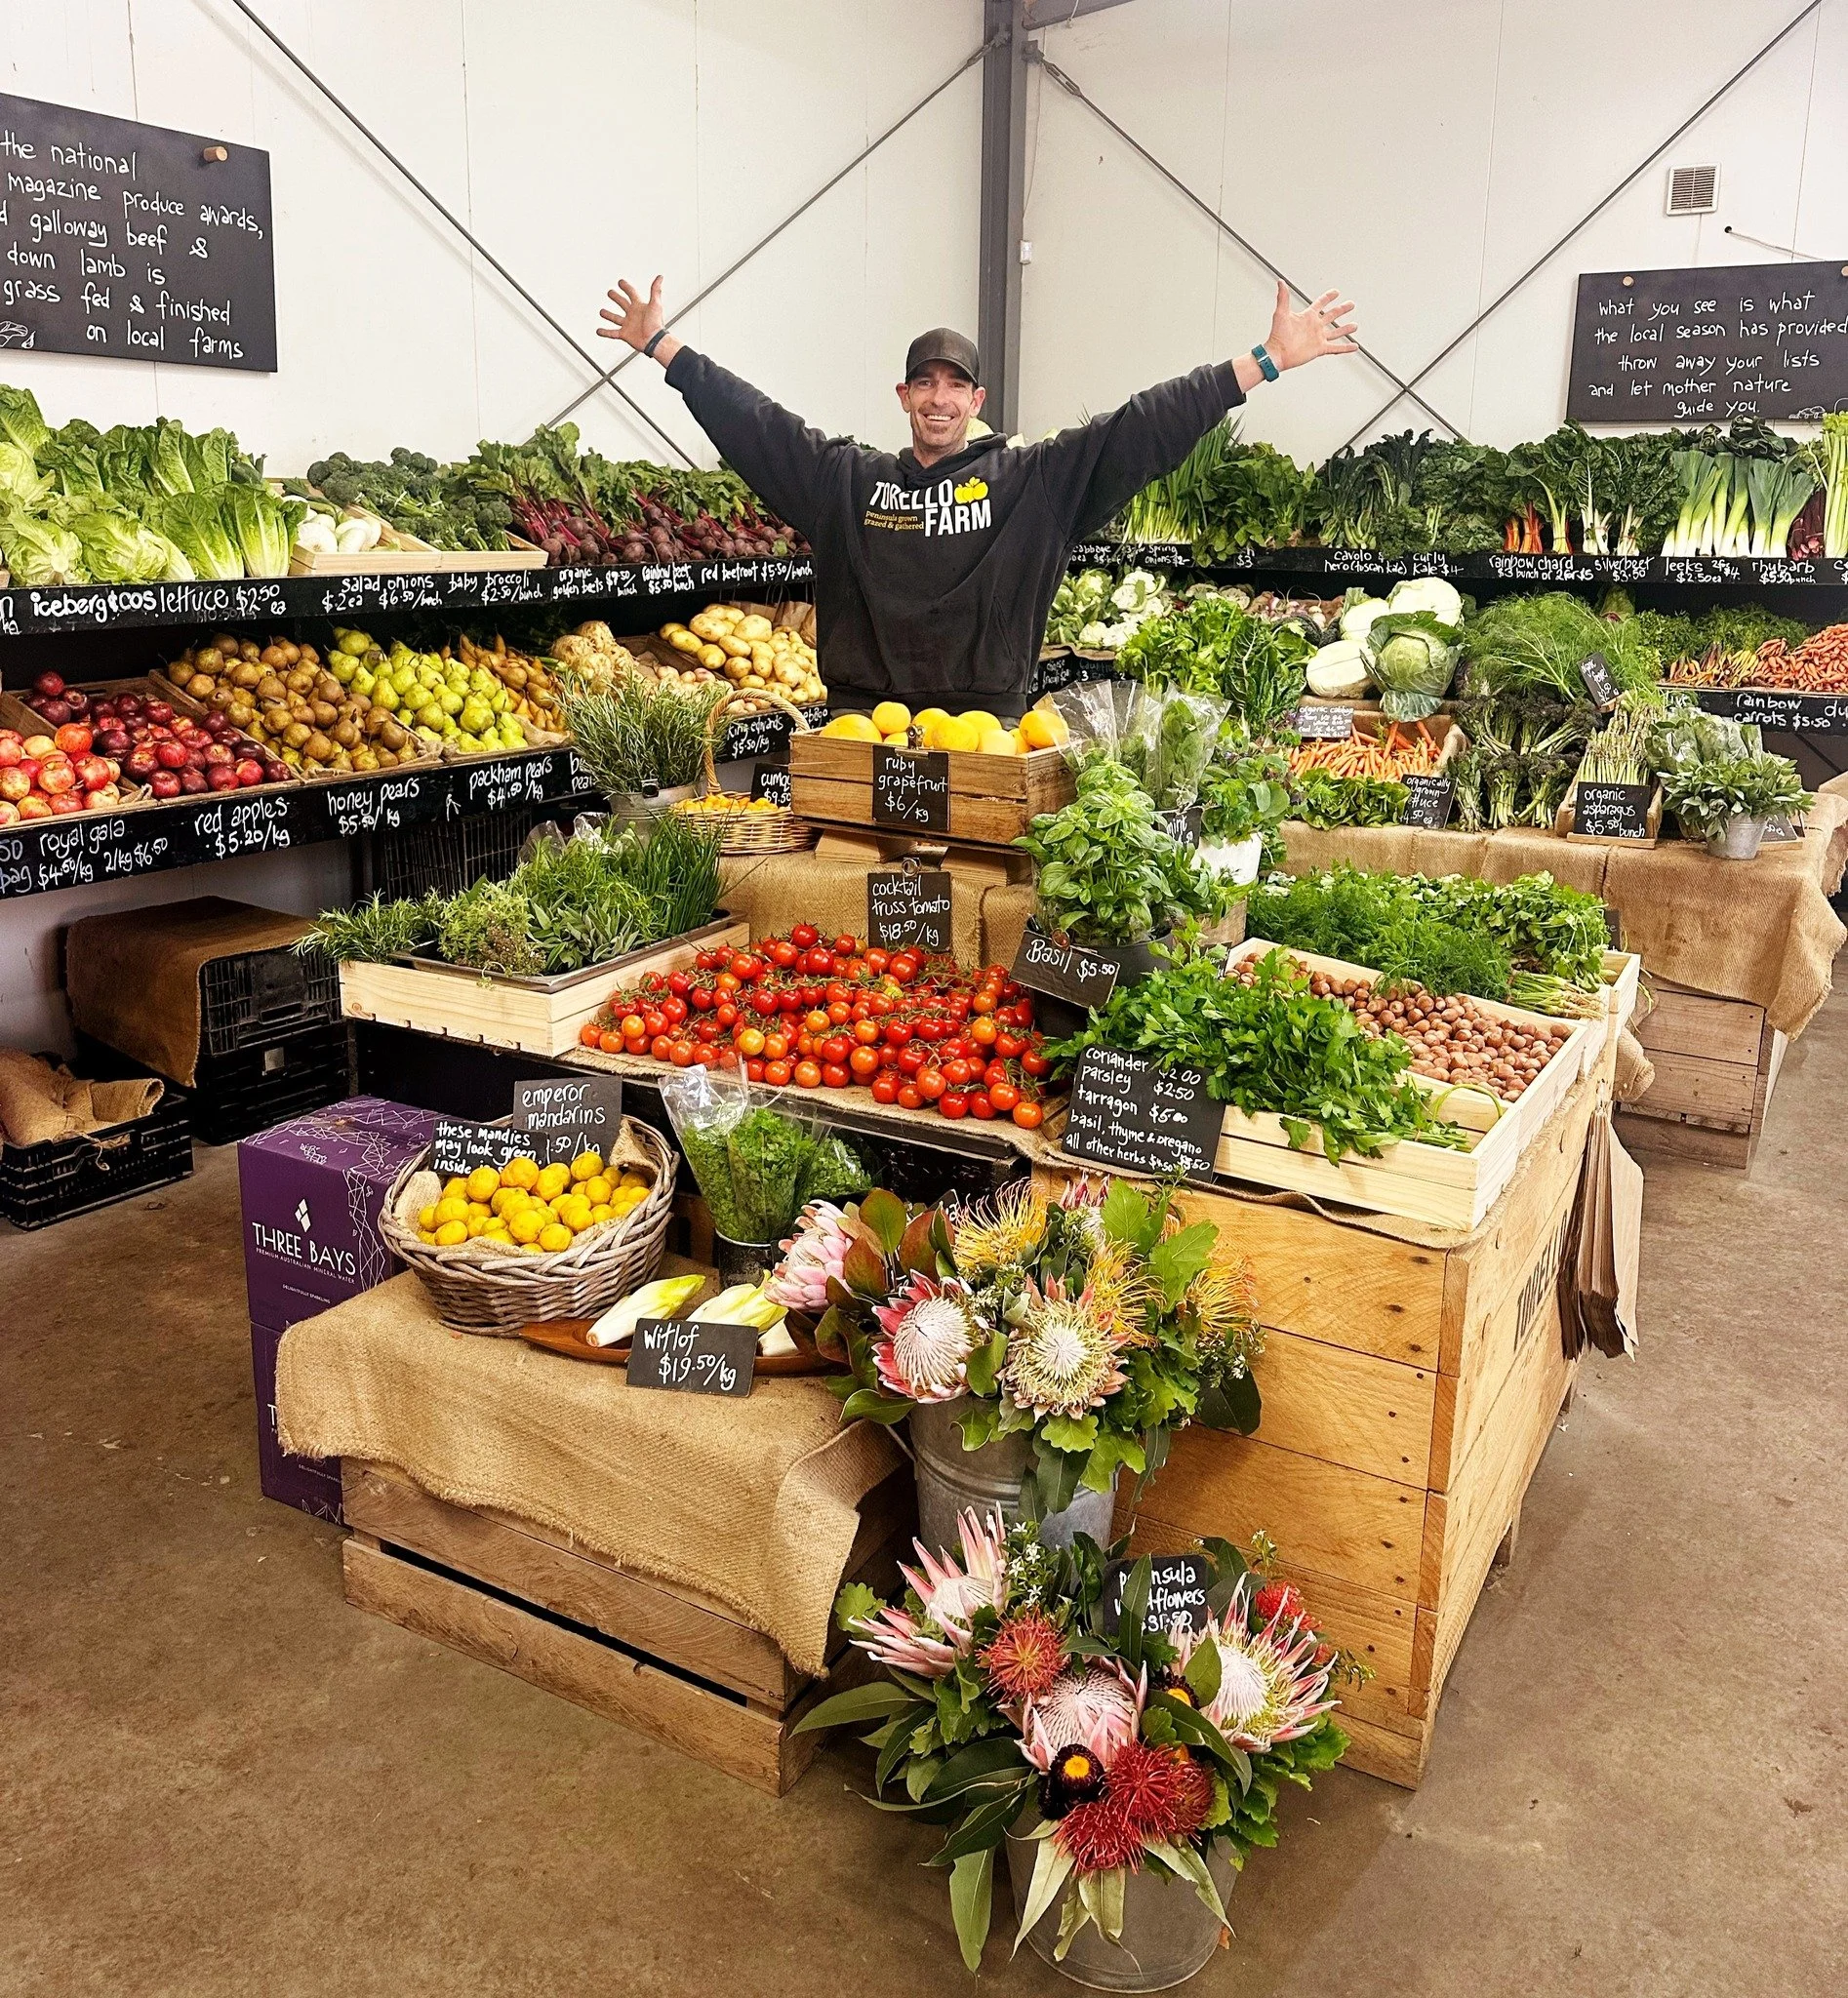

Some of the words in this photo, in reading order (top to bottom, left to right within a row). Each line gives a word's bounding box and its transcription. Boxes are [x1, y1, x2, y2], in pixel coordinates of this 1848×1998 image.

[1, 130, 36, 159] the
[51, 142, 137, 180] national
[8, 173, 101, 201] magazine
[123, 191, 185, 218] produce
[199, 205, 263, 239] awards,
[30, 209, 107, 247] galloway
[127, 221, 168, 255] beef
[189, 237, 208, 259] &
[7, 242, 56, 269] down
[81, 249, 126, 277] lamb
[146, 262, 166, 285] is
[4, 280, 60, 304] grass
[81, 282, 109, 314] fed
[129, 295, 144, 314] &
[156, 291, 230, 325] finished
[1598, 298, 1635, 317] what
[1648, 302, 1680, 321] you
[1693, 300, 1717, 315] see
[1739, 297, 1754, 313] is
[1769, 291, 1815, 313] what
[87, 324, 106, 342] on
[127, 319, 164, 350] local
[189, 327, 244, 359] farms
[1594, 327, 1619, 345] the
[1630, 323, 1665, 343] local
[1675, 325, 1726, 340] season
[1739, 320, 1769, 339] has
[1776, 317, 1848, 346] provided
[1619, 354, 1658, 372] throw
[1675, 354, 1716, 377] away
[1726, 354, 1763, 376] your
[1784, 349, 1821, 368] lists
[1588, 383, 1614, 397] and
[1630, 379, 1653, 396] let
[1662, 378, 1717, 397] mother
[1733, 374, 1791, 393] nature
[1673, 398, 1714, 419] guide
[1726, 400, 1760, 417] you.
[869, 478, 953, 510] TORELLO
[864, 518, 887, 528] grazed
[895, 521, 924, 531] gathered
[865, 510, 898, 521] peninsula
[925, 499, 991, 537] FARM
[1334, 549, 1372, 561] cavolo
[1413, 551, 1445, 567] curly
[1489, 555, 1535, 570] rainbow
[1538, 555, 1574, 570] chard
[1594, 555, 1655, 572] silverbeet
[1665, 557, 1704, 576] leeks
[1752, 560, 1815, 574] rhubarb
[341, 574, 381, 593] salad
[387, 575, 435, 590] onions
[448, 573, 478, 594] baby
[485, 570, 532, 588] broccoli
[702, 564, 718, 584] red
[722, 561, 759, 581] beetroot
[1498, 568, 1513, 578] $3
[1516, 568, 1539, 579] bunch
[1613, 569, 1646, 582] $3.50
[160, 585, 229, 615] lettuce
[236, 584, 280, 617] $2.50
[270, 600, 287, 615] ea
[1737, 693, 1802, 709] rainbow
[750, 715, 784, 734] edwards
[1734, 711, 1787, 727] carrots
[1792, 713, 1830, 731] $5.50
[732, 735, 770, 759] $5.50/kg
[469, 762, 521, 800] packham
[526, 755, 552, 786] pears
[886, 756, 915, 779] ruby
[327, 791, 373, 817] honey
[381, 778, 420, 815] pears
[878, 775, 947, 795] grapefruit
[1406, 777, 1451, 794] organically
[1416, 786, 1440, 798] grown
[1585, 787, 1626, 807] organic
[194, 804, 221, 836] red
[231, 796, 288, 832] apples
[884, 791, 929, 822] $6/kg
[1583, 804, 1635, 823] asparagus
[39, 823, 85, 859] royal
[89, 819, 125, 854] gala
[215, 820, 290, 859] $5.20/kg
[1586, 819, 1619, 835] $5.50
[1619, 822, 1645, 838] bunch
[37, 851, 94, 891] $4.50/kg
[872, 875, 922, 896] cocktail
[871, 899, 906, 916] truss
[909, 895, 950, 915] tomato
[879, 920, 940, 946] $18.50/kg
[1025, 939, 1072, 974] Basil
[1076, 959, 1116, 983] $5.50
[1086, 1047, 1148, 1072] coriander
[1081, 1065, 1131, 1094] parsley
[1153, 1080, 1194, 1100] $2.50
[522, 1083, 590, 1111] emperor
[1078, 1084, 1138, 1117] tarragon
[527, 1103, 606, 1130] mandarins
[436, 1121, 472, 1139] these
[478, 1128, 531, 1145] mandies
[1070, 1109, 1105, 1135] basil,
[1108, 1121, 1145, 1145] thyme
[1146, 1133, 1156, 1143] &
[1157, 1135, 1202, 1157] oregano
[435, 1139, 462, 1159] may
[466, 1140, 493, 1156] look
[1065, 1133, 1080, 1149] all
[1086, 1137, 1115, 1157] other
[1117, 1146, 1145, 1164] herbs
[434, 1154, 471, 1174] inside
[253, 1222, 301, 1259] THREE
[310, 1240, 355, 1275] BAYS
[256, 1248, 279, 1259] PREMIUM
[280, 1256, 311, 1269] AUSTRALIAN
[313, 1266, 336, 1278] MINERAL
[338, 1274, 355, 1284] WATER
[659, 1352, 737, 1391] $19.50/kg
